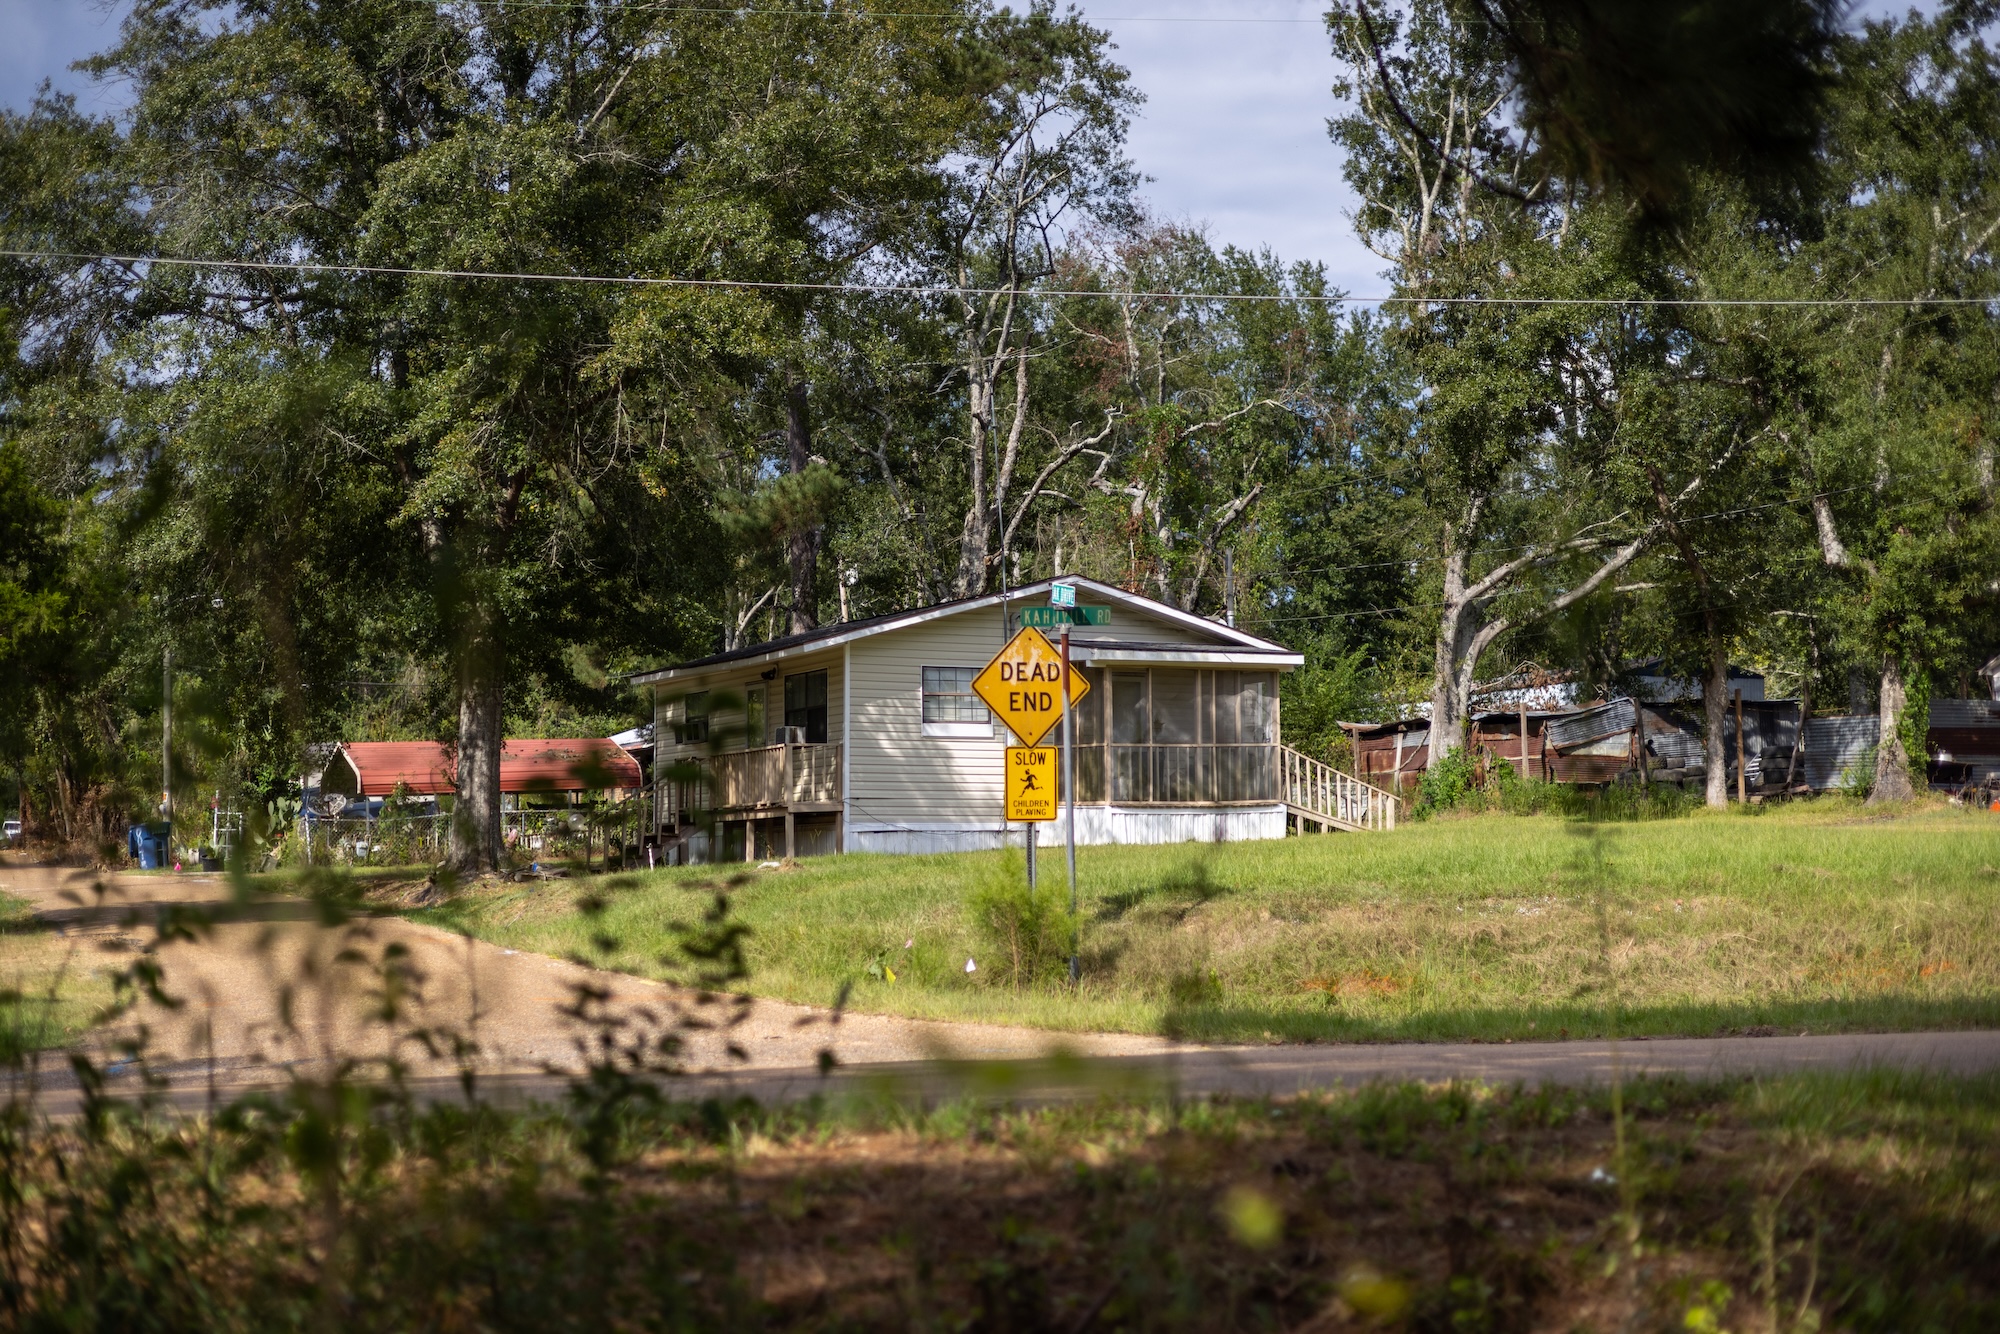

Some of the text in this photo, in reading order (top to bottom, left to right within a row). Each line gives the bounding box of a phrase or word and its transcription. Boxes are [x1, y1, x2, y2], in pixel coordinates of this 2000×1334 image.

[1097, 609, 1111, 623] RD
[1001, 662, 1060, 681] DEAD
[1010, 692, 1052, 711] END
[1015, 752, 1046, 765] SLOW
